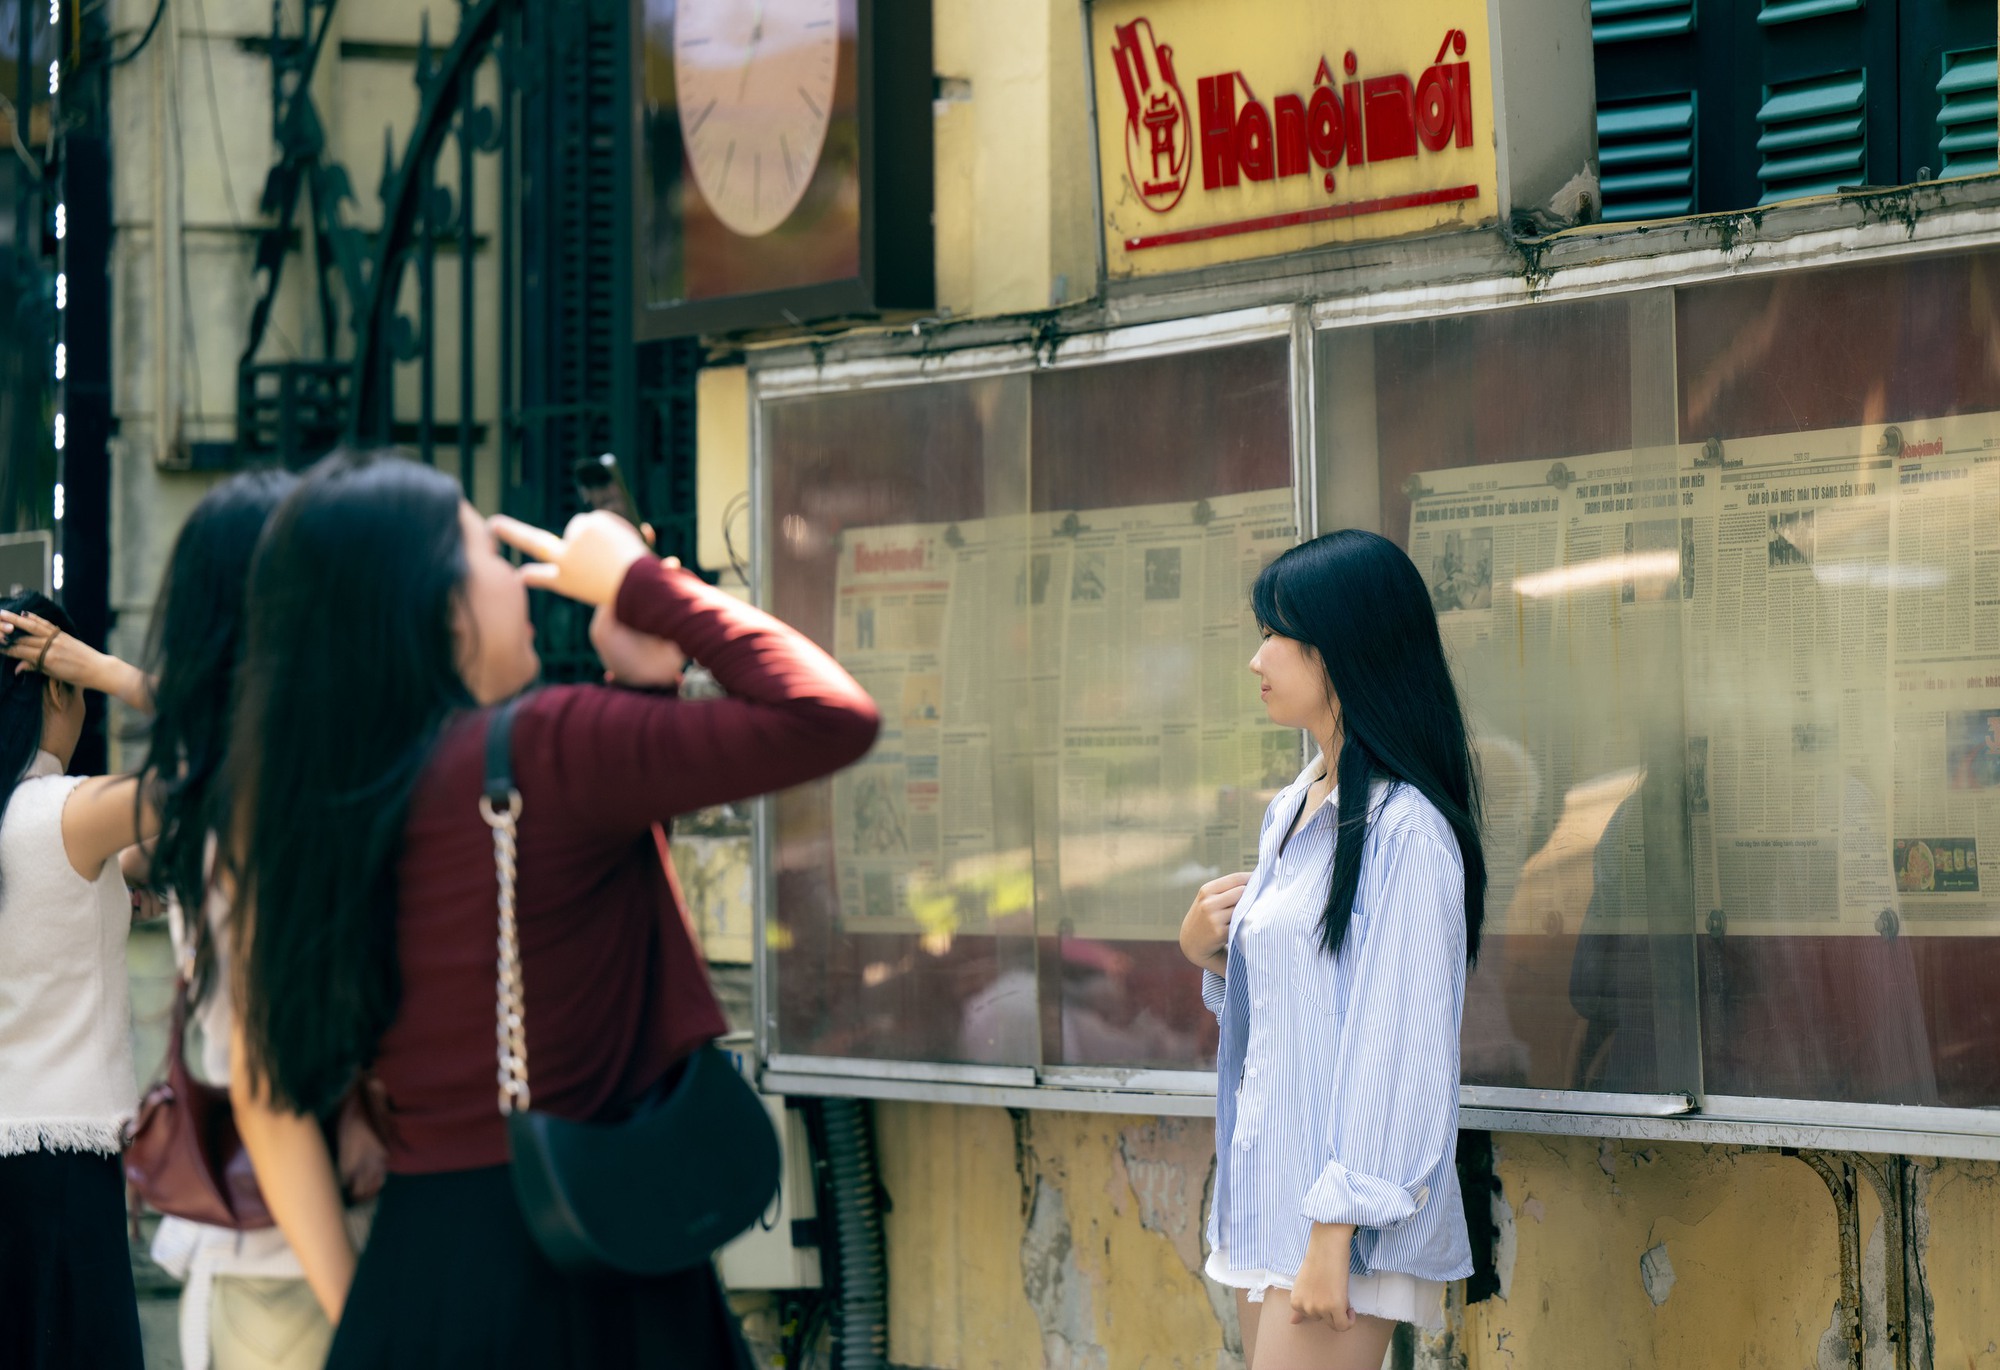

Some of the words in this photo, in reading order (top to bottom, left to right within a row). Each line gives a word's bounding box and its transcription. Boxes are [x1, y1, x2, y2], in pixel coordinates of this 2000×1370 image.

[1761, 489, 1770, 506] BỘ
[1780, 487, 1795, 506] MIỆT
[1820, 483, 1838, 499] SÁNG
[1840, 480, 1853, 497] ĐẾN
